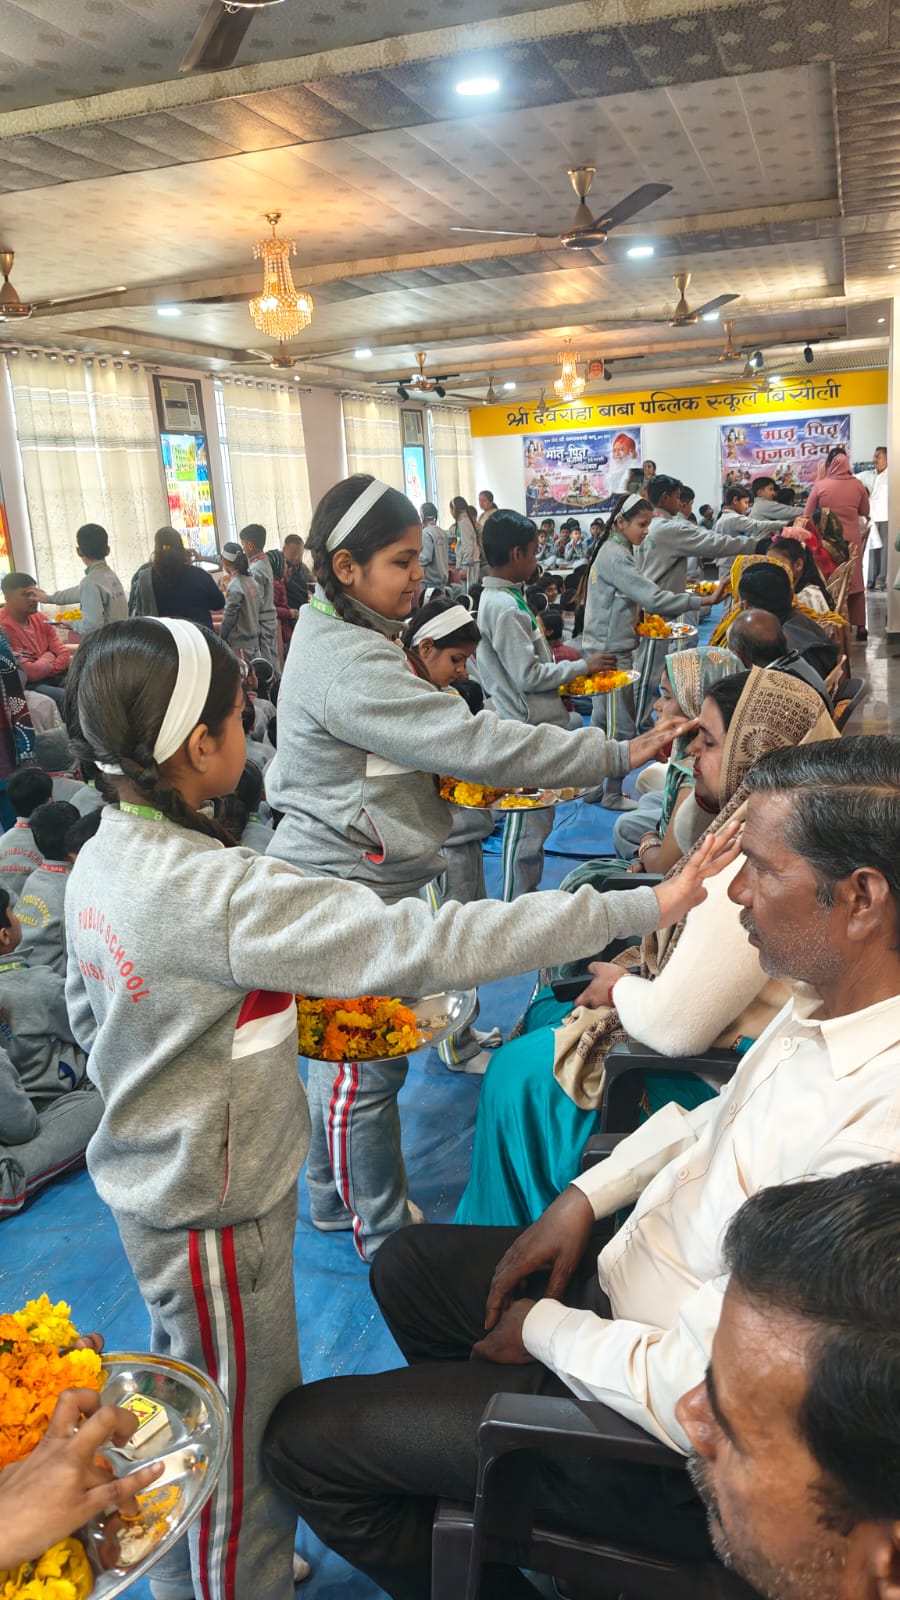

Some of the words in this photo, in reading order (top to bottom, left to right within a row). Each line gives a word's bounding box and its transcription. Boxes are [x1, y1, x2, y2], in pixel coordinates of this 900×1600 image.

[507, 407, 529, 426] श्री
[599, 402, 635, 417] बाबा
[640, 391, 702, 414] पब्लिक
[706, 391, 758, 411] स्कूल
[755, 446, 796, 464] पूजन
[79, 907, 105, 934] PUBLIC
[105, 922, 150, 1003] SCHOOL
